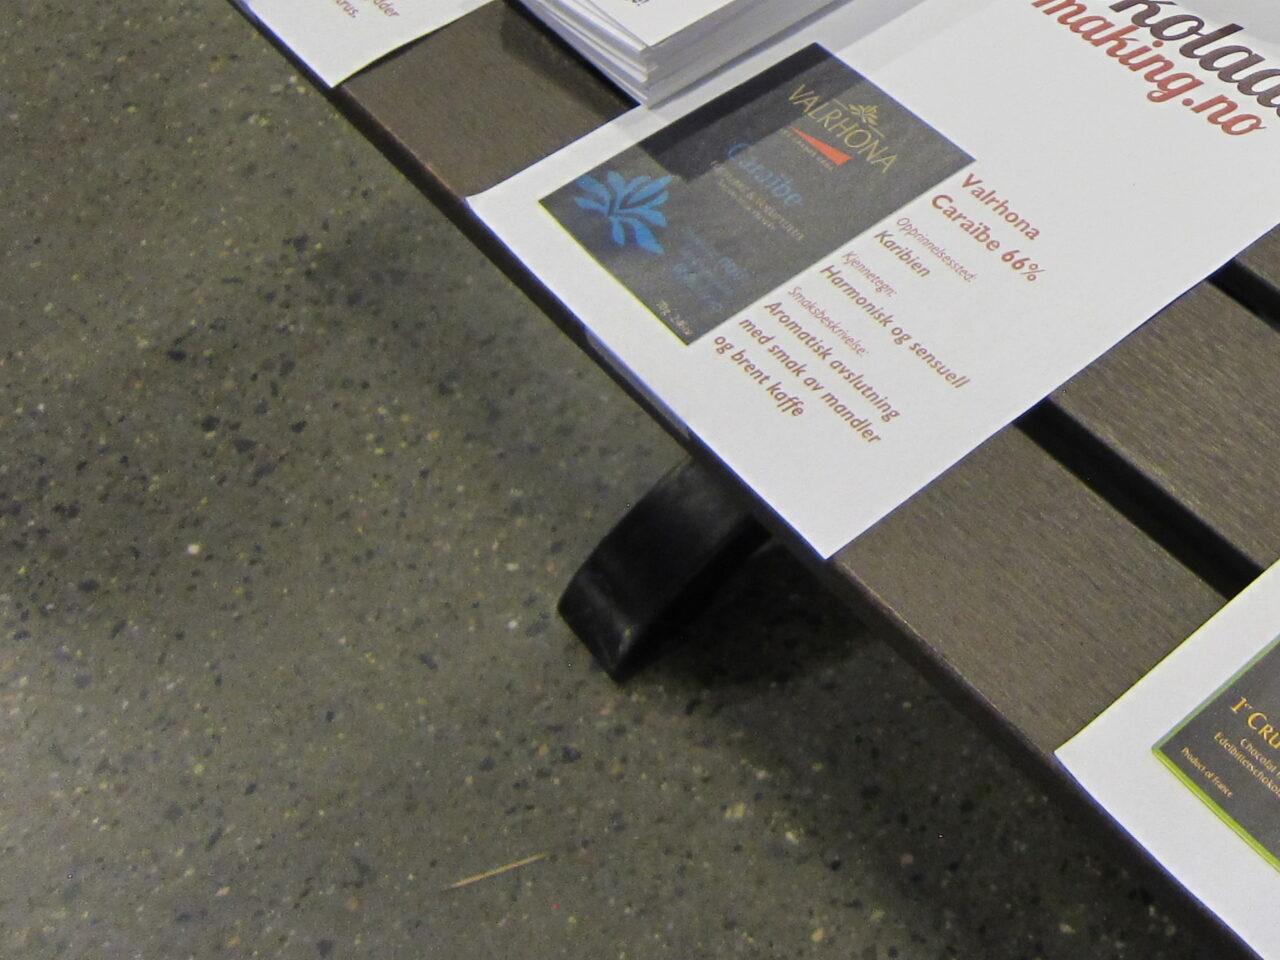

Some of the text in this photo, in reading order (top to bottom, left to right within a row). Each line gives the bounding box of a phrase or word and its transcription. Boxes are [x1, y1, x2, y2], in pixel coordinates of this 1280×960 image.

[788, 84, 898, 173] VALRHONA
[930, 193, 1046, 283] Caraïbe 66%
[960, 172, 1041, 241] Valrhona
[873, 230, 931, 278] Karibien
[763, 301, 901, 423] Aromatisk avslutning
[819, 264, 972, 390] Harmonisk og sensuell
[713, 335, 805, 419] og brent kaffe
[738, 317, 883, 446] med smak av mandler
[1240, 738, 1275, 773] Chocolat
